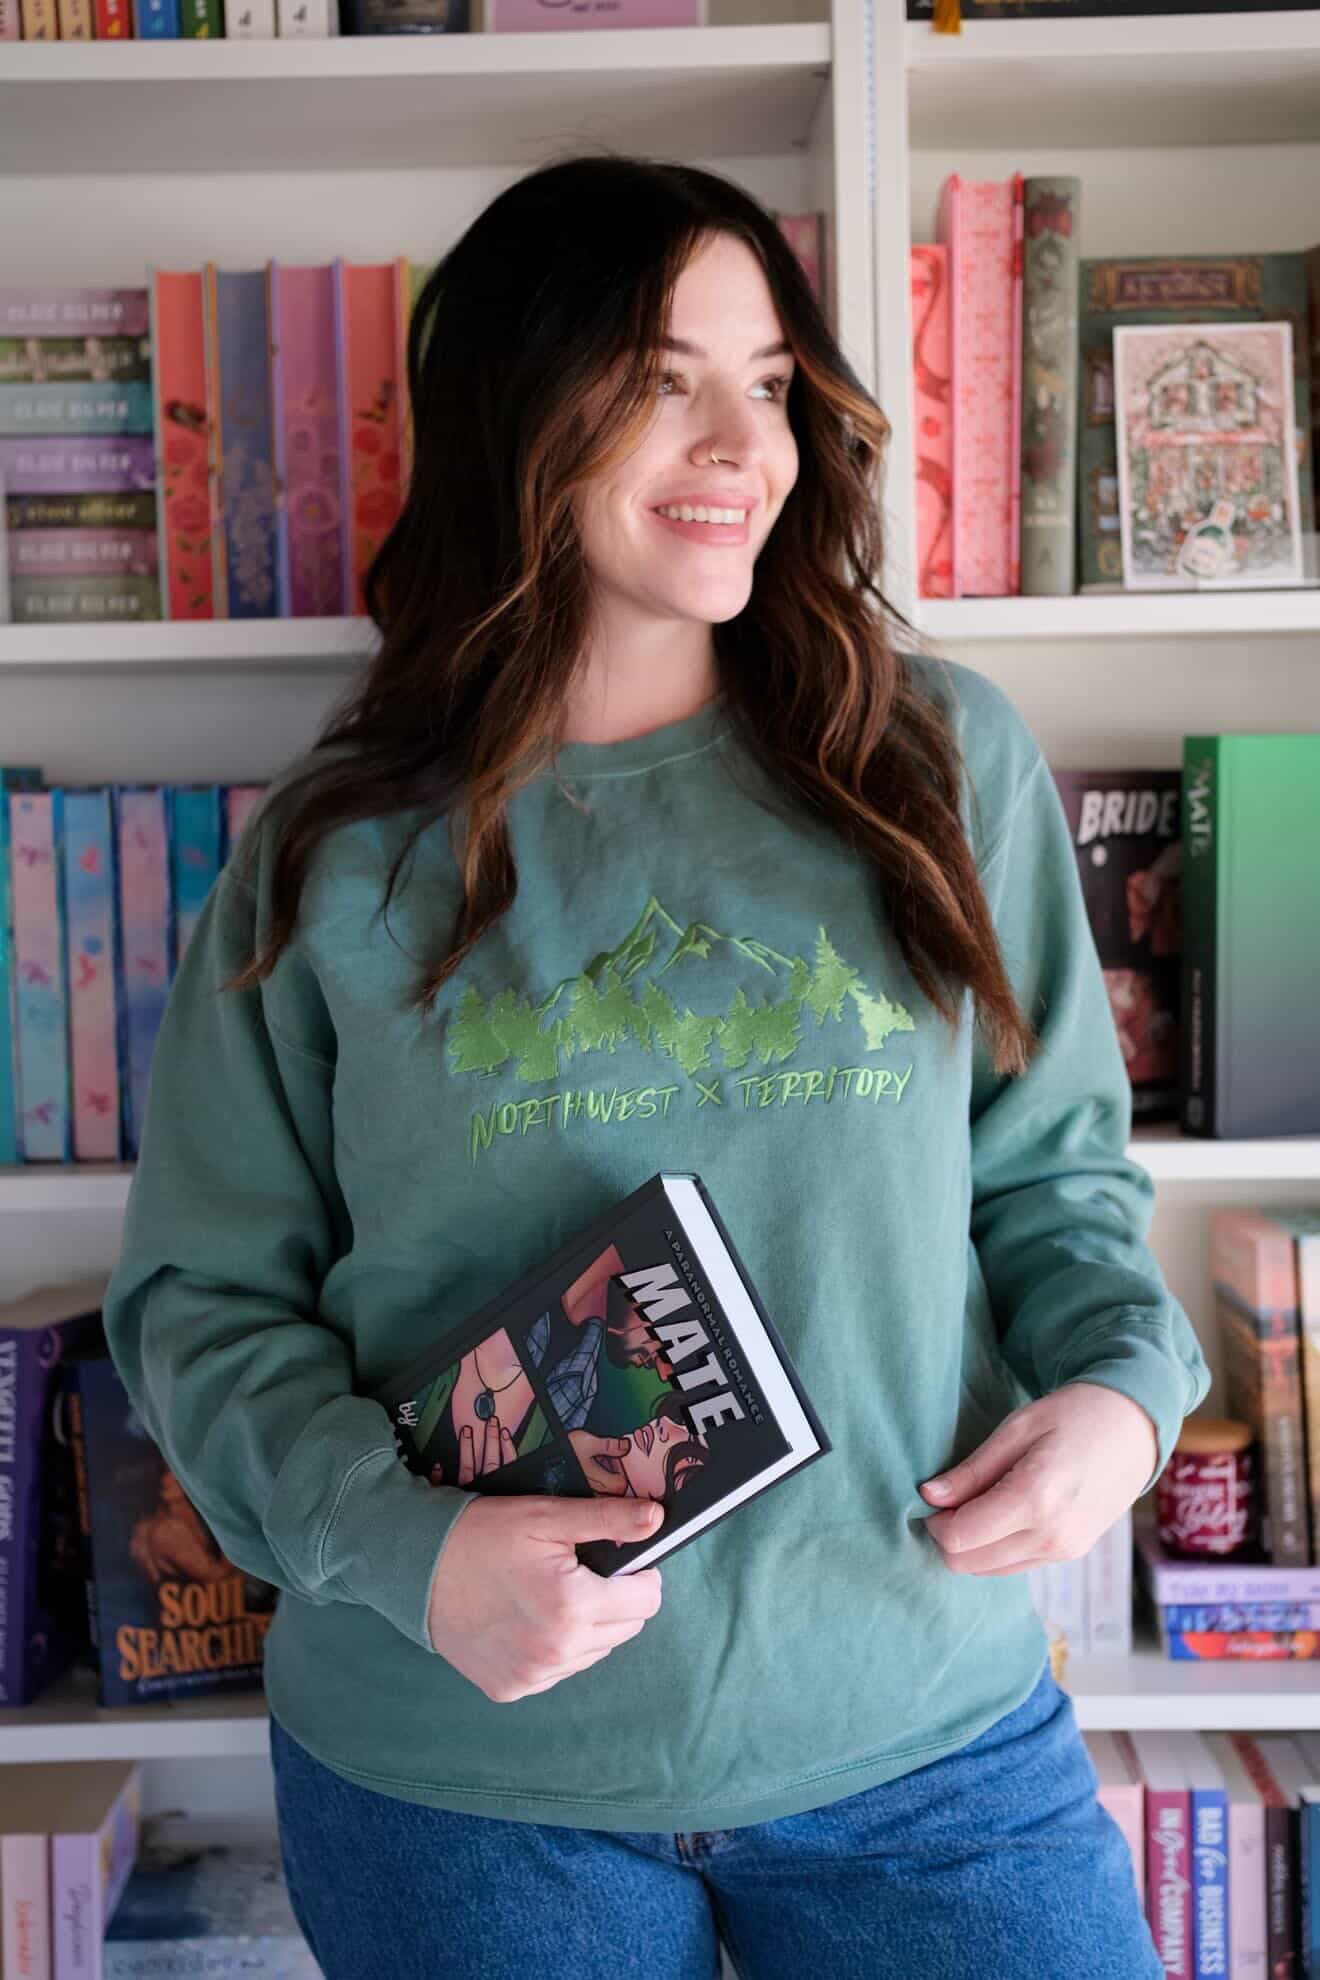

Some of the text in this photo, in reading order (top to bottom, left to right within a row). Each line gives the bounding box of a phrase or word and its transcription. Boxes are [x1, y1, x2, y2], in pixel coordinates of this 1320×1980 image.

[1076, 790, 1177, 846] BRIDE
[470, 1086, 679, 1167] NORTHWEST
[736, 1063, 914, 1108] TERRITORY
[619, 1263, 746, 1436] MATE
[664, 1230, 765, 1426] A PARANORMAL ROMANCE
[398, 1401, 419, 1426] by
[159, 1576, 268, 1632] SOUL
[1193, 1807, 1227, 1975] BAD for BUSINESS
